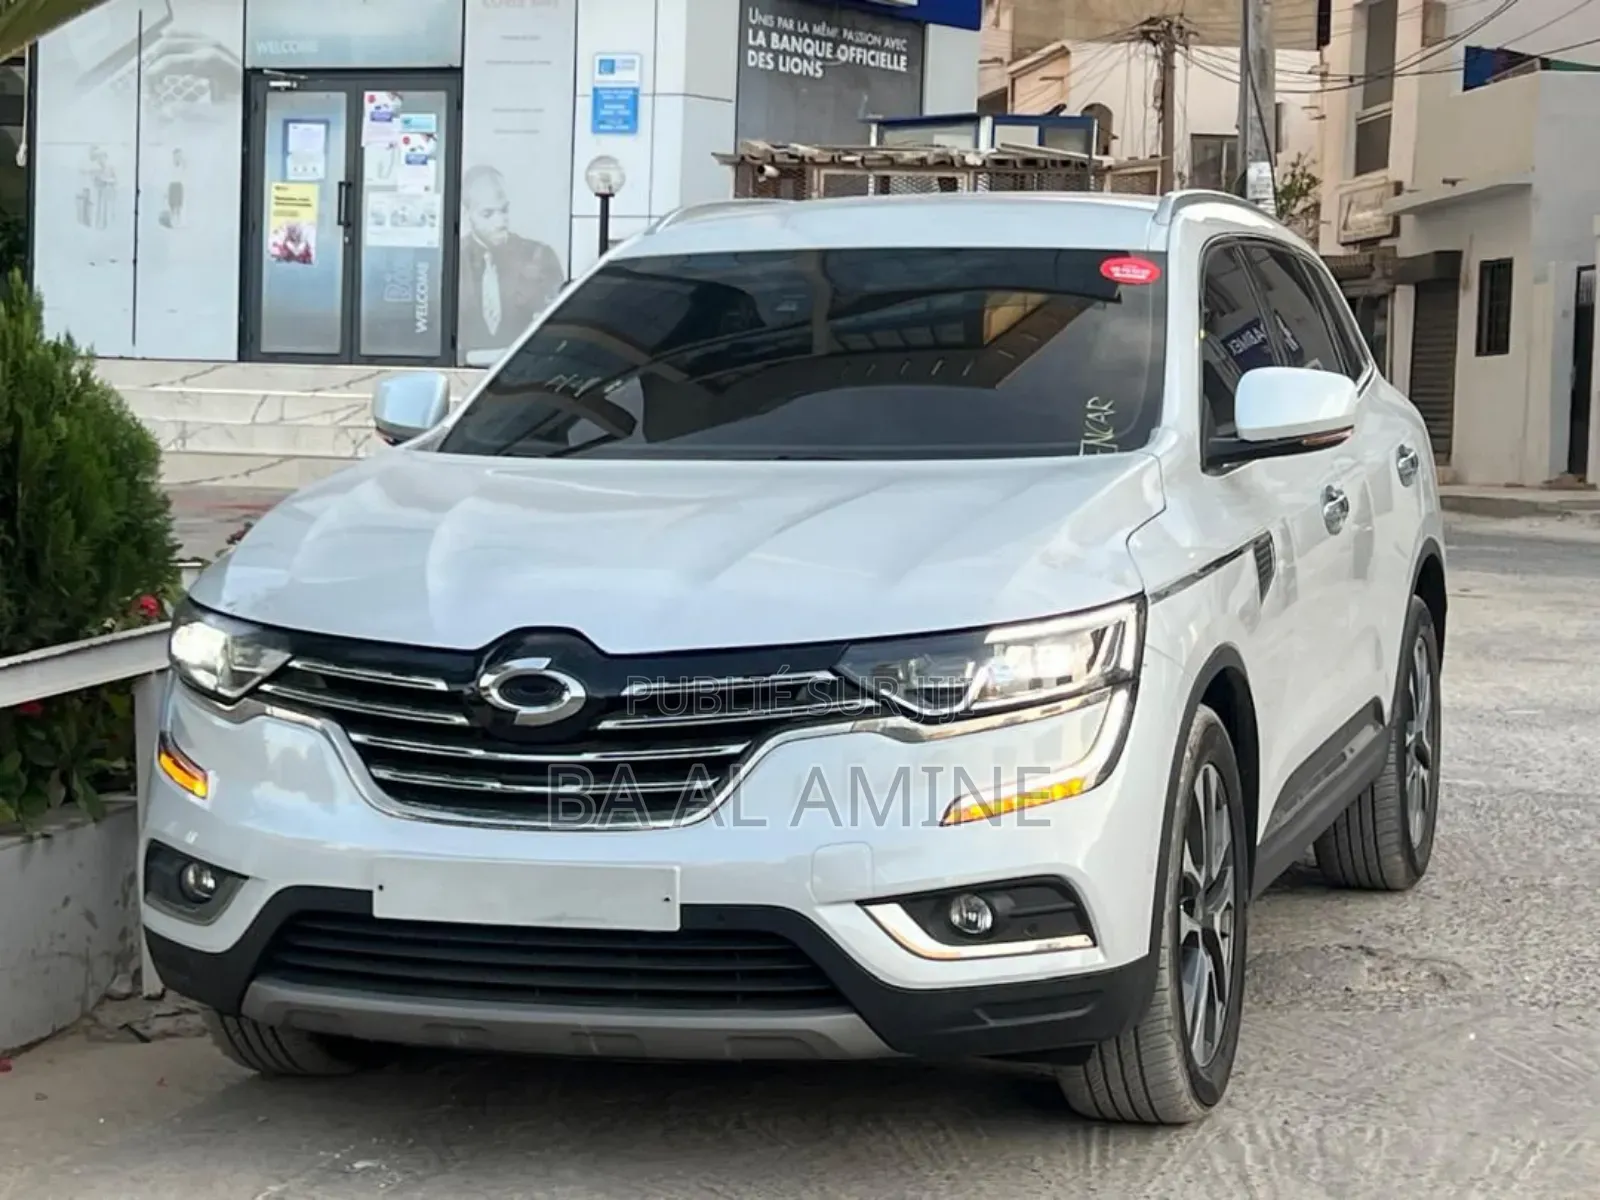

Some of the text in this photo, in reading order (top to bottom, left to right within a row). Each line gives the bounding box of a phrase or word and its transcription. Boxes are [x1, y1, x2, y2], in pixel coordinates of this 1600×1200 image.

[748, 28, 908, 72] LA BANQUE OFFICIELLE
[777, 16, 795, 31] PAR
[797, 20, 810, 34] LA
[883, 36, 908, 51] AVEC
[747, 50, 824, 78] DES LIONS
